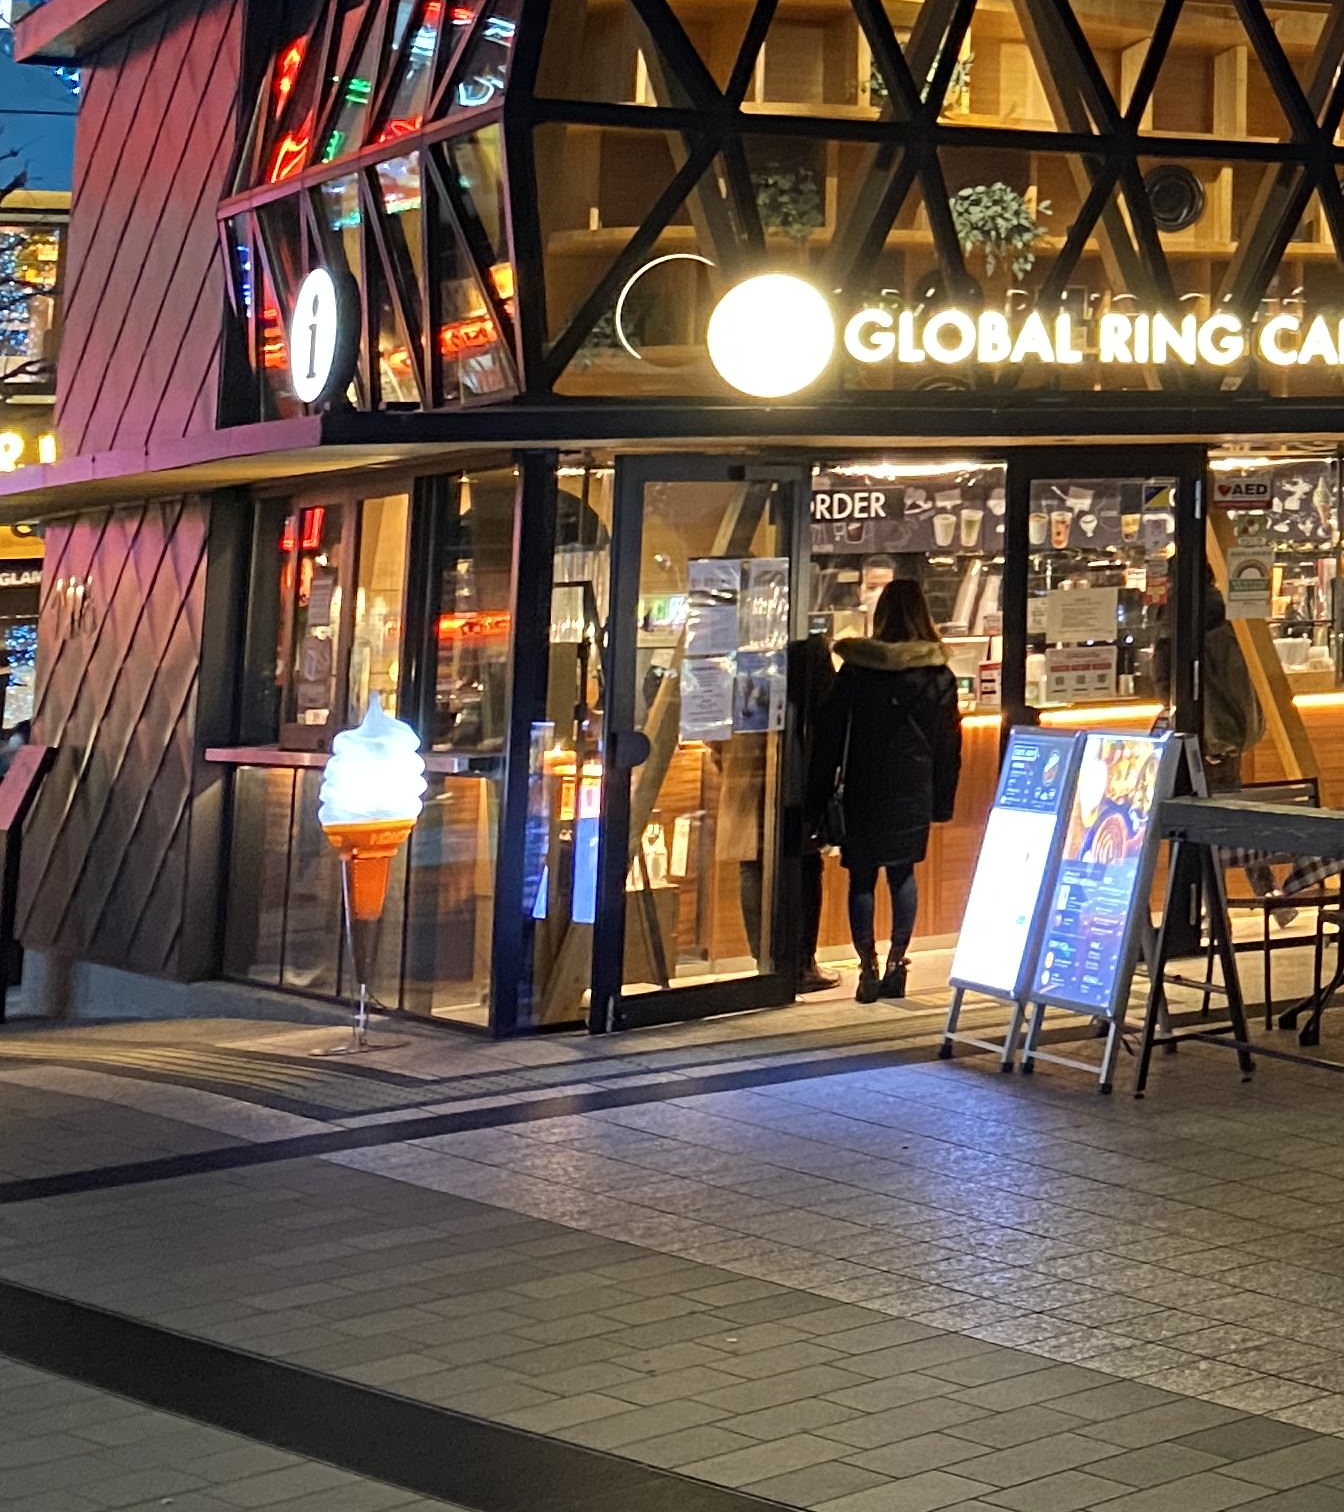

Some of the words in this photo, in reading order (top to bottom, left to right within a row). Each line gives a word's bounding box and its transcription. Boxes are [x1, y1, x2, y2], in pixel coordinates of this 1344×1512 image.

[843, 309, 1083, 365] GLOBAL
[1099, 313, 1244, 366] RING
[1231, 484, 1268, 496] AED
[809, 491, 887, 520] RDER
